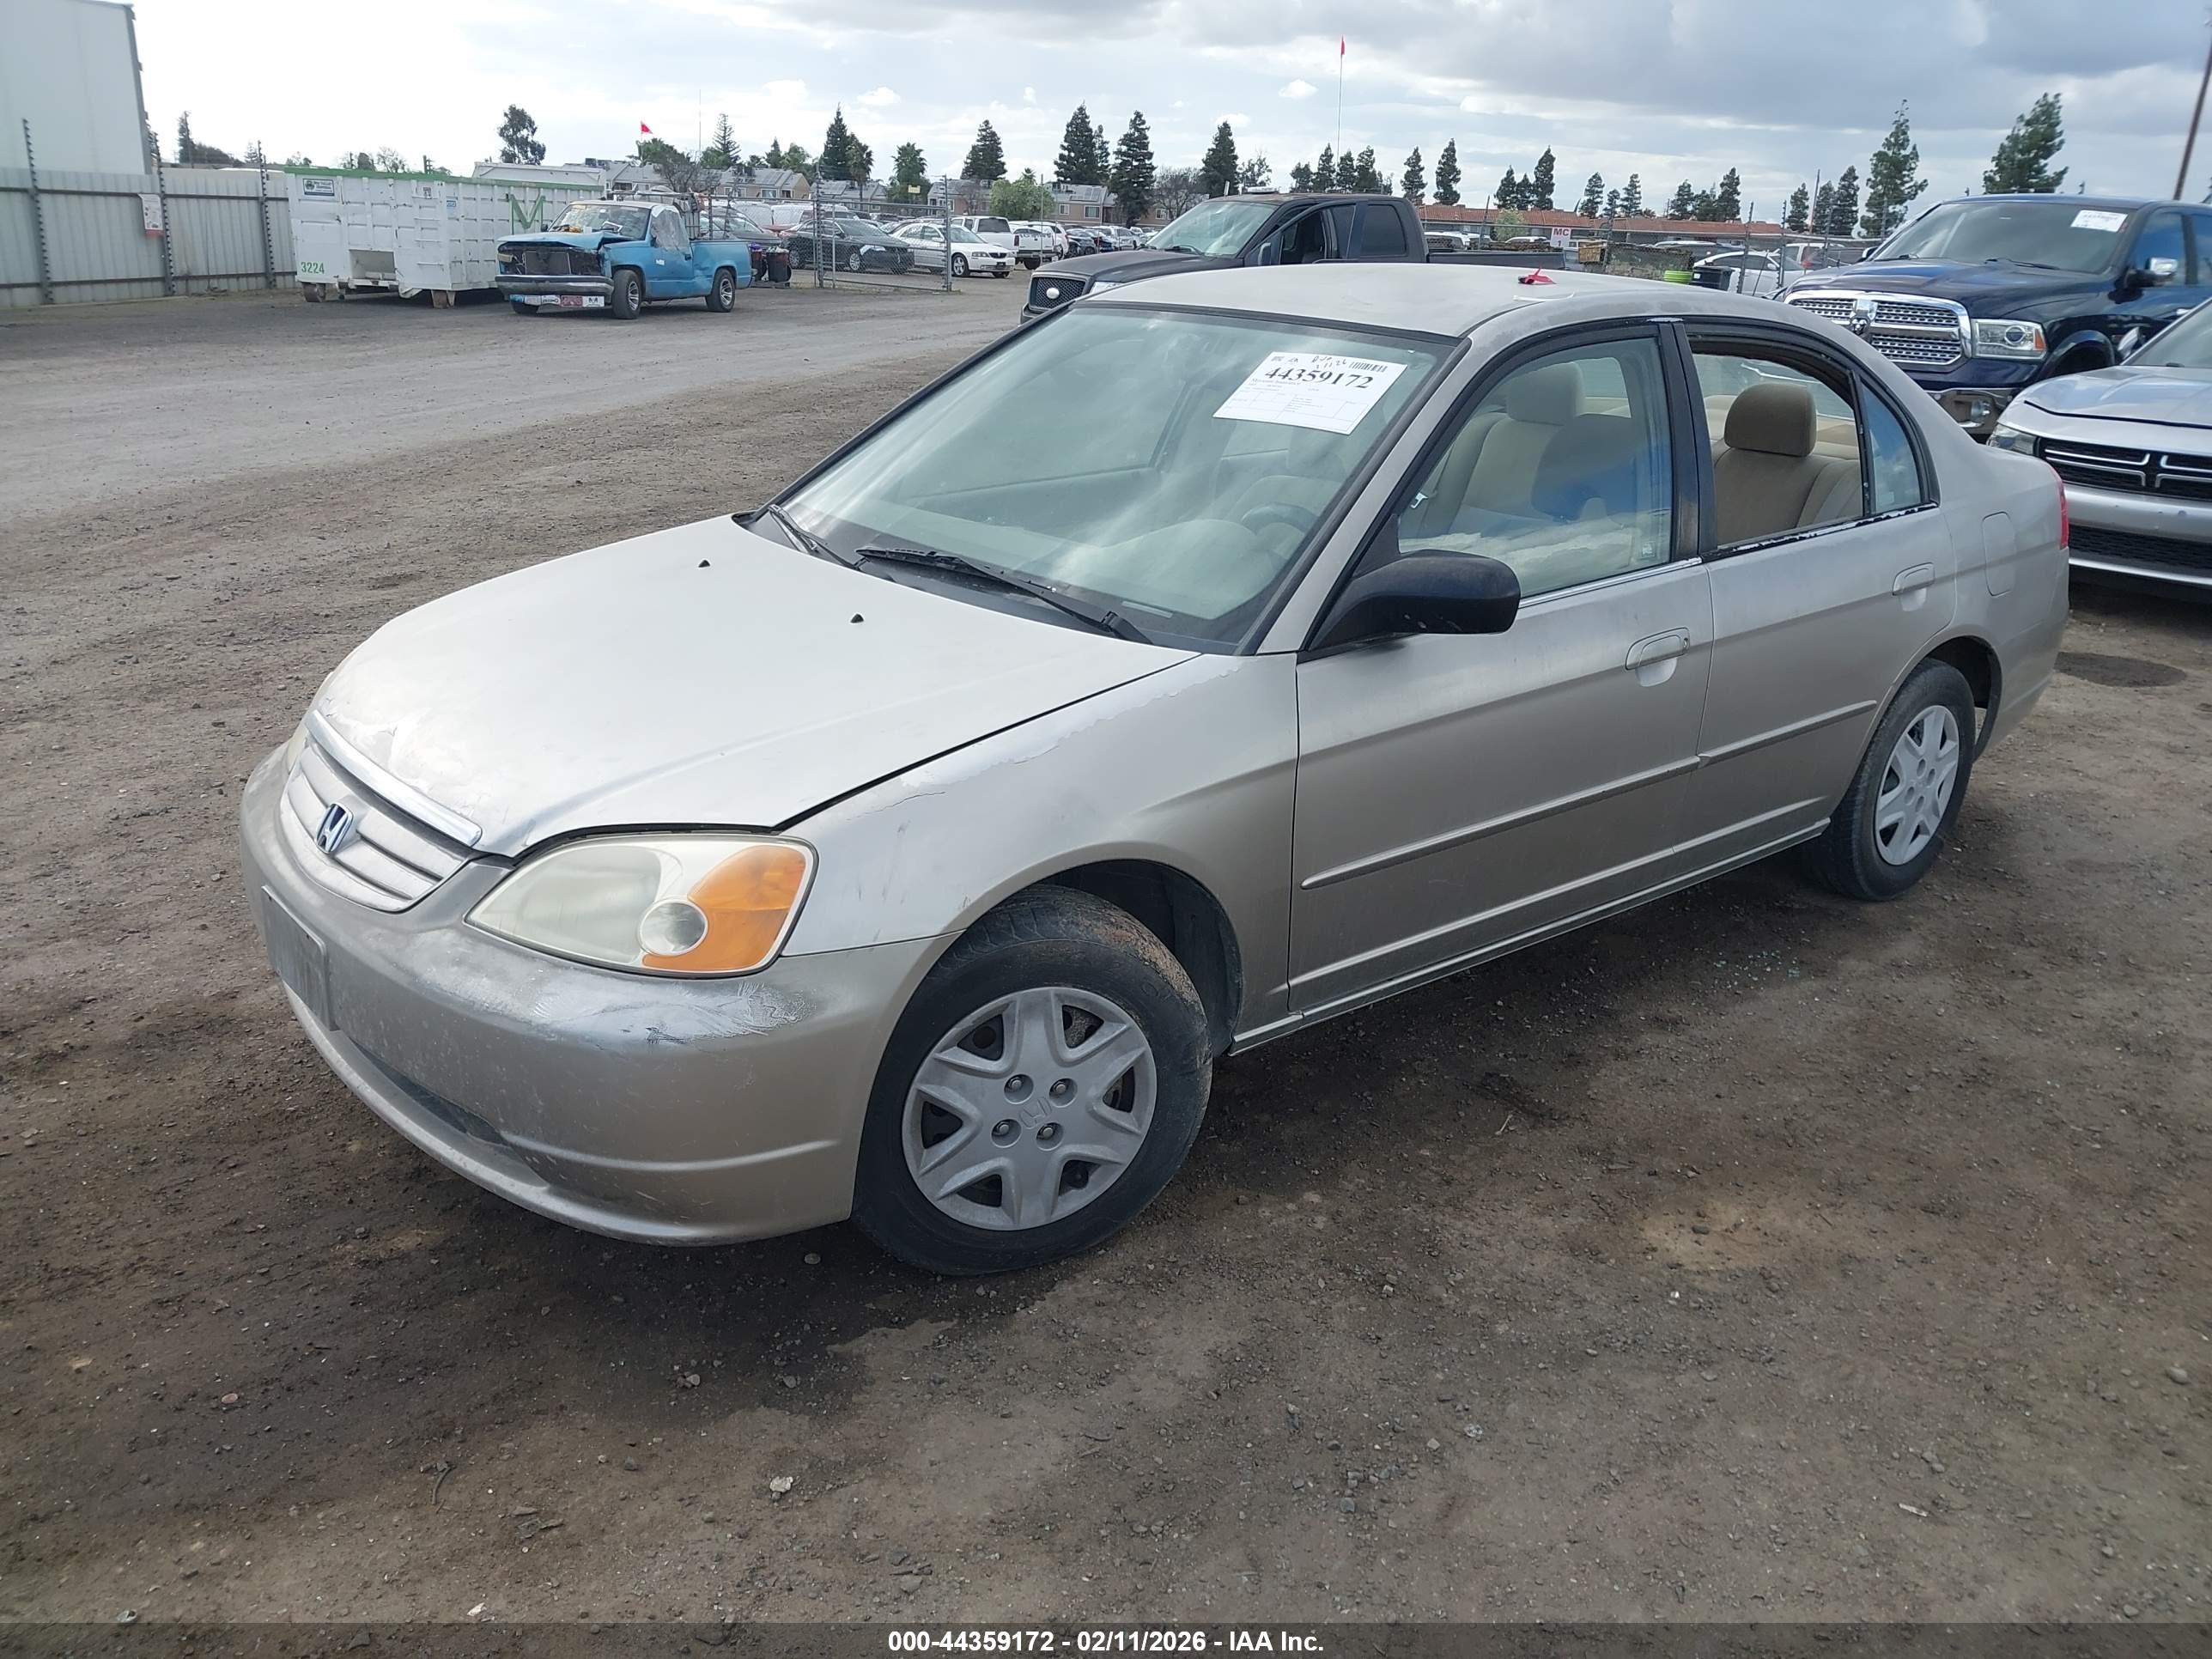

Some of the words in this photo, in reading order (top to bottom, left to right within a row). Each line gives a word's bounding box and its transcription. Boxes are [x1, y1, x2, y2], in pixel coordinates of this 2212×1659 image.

[1553, 228, 1570, 236] MC
[301, 261, 325, 274] 3224
[1264, 367, 1374, 389] 44359172
